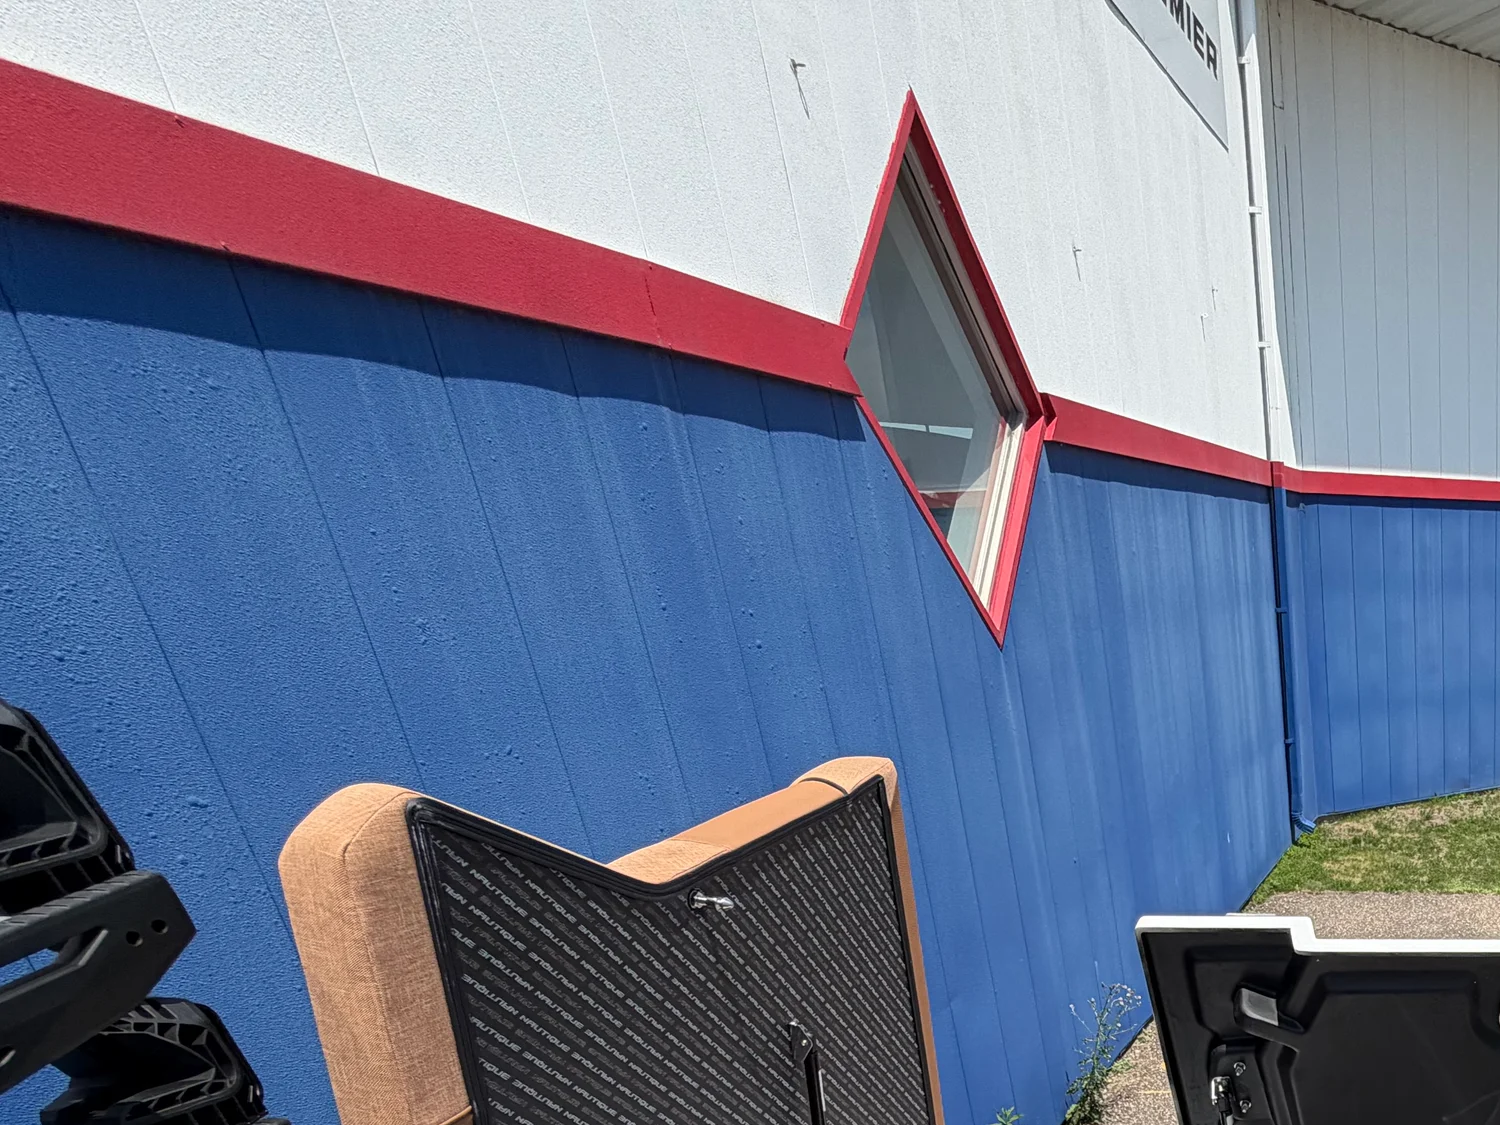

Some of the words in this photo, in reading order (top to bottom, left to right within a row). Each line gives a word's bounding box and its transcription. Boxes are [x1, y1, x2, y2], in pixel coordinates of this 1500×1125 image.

[1161, 0, 1218, 81] MIER
[432, 840, 468, 867] NAUT
[469, 868, 528, 917] NAUTIQUE
[528, 916, 580, 960] NAUTIQUE
[579, 959, 625, 998] NAUTIQUE
[467, 904, 527, 951] NAUTIQUE
[527, 951, 578, 992] NAUTIQUE
[577, 990, 623, 1028] NAUTIQUE
[481, 843, 524, 878] NAUTI
[524, 878, 577, 923] NAUTIQUE
[577, 923, 623, 965] NAUTIQUE
[622, 964, 664, 1001] NAUTIQUE
[586, 899, 632, 941] NAUTIQUE
[631, 940, 672, 978] NAUTIQUE
[630, 907, 670, 947] NAUTIQUE
[461, 972, 519, 1017] NAUTIQUE
[518, 1014, 570, 1052] NAUTIQUE
[570, 1051, 616, 1085] NAUTIQUE
[477, 948, 534, 991] NAUTIQUE
[533, 990, 584, 1029] NAUTIQUE
[583, 1028, 628, 1063] NAUTIQUE
[478, 1057, 511, 1082] TIQUE
[511, 1078, 563, 1113] NAUTIQUE
[521, 1050, 572, 1086] NAUTIQUE
[572, 1084, 617, 1116] NAUTIQUE
